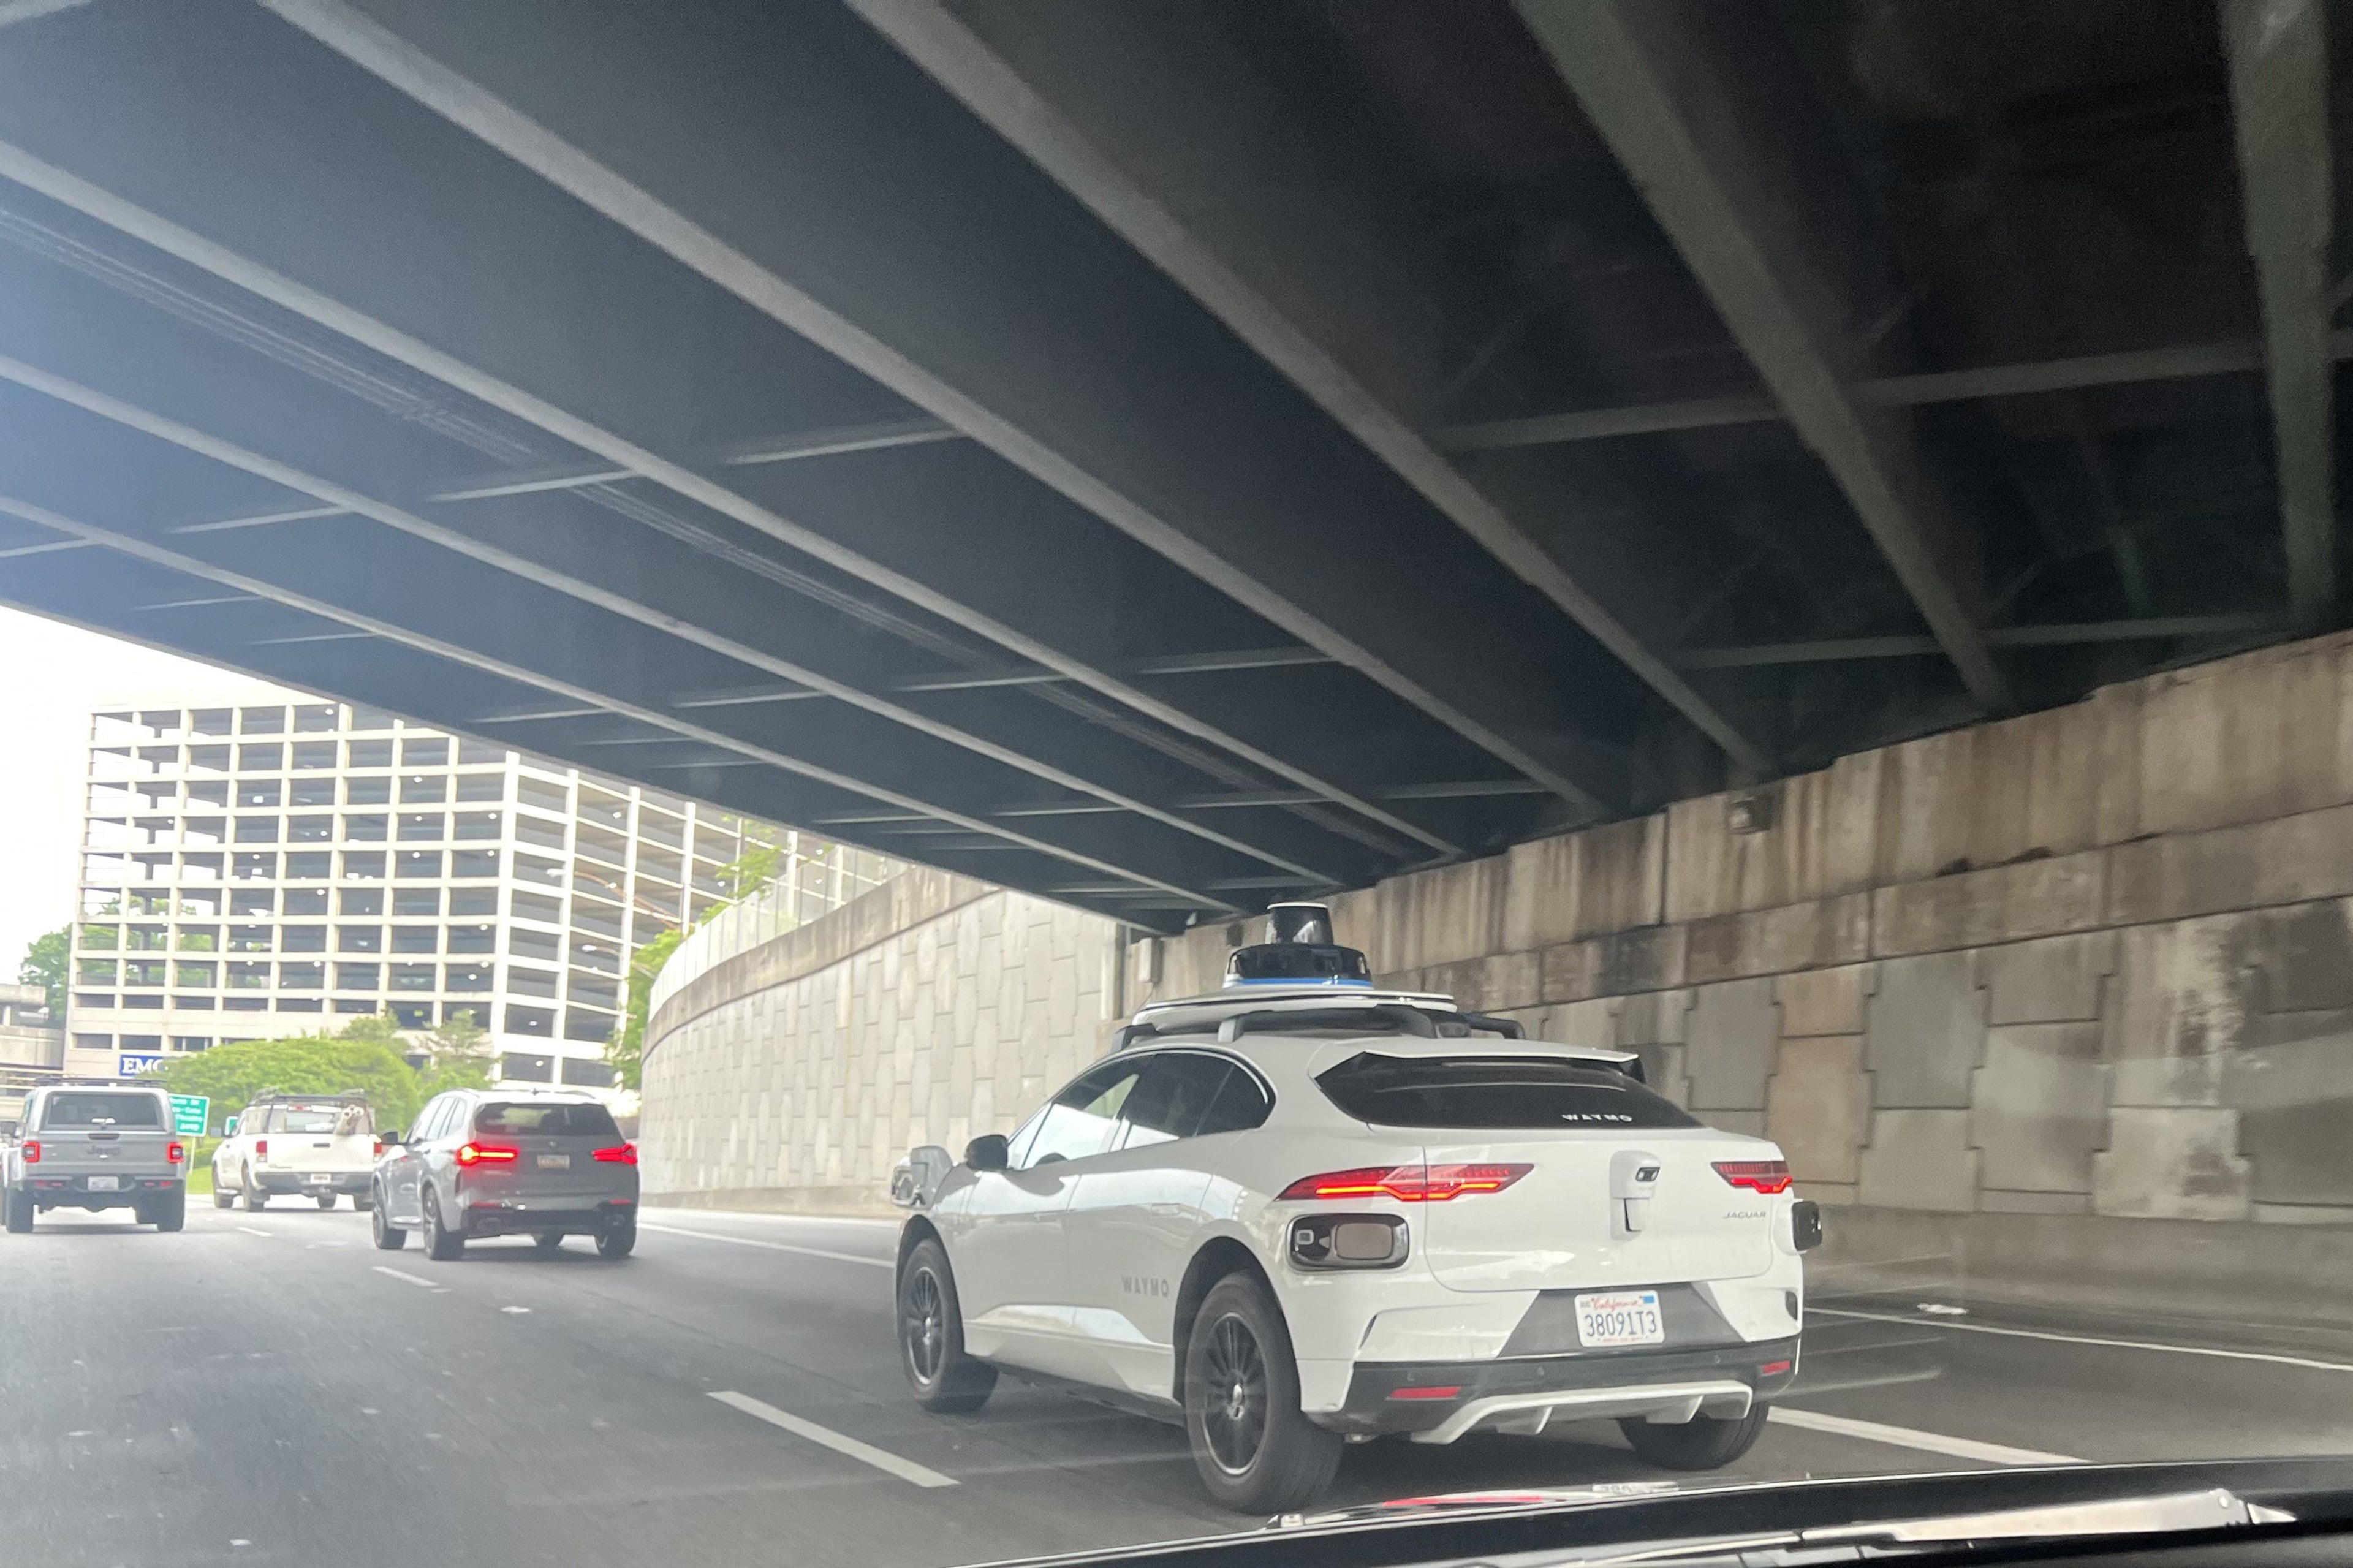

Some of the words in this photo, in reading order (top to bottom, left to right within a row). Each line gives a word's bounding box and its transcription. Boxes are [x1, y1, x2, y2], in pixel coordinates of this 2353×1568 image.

[1121, 1274, 1169, 1298] WAYMO
[1593, 1296, 1639, 1312] California
[1584, 1311, 1657, 1337] 38091T3
